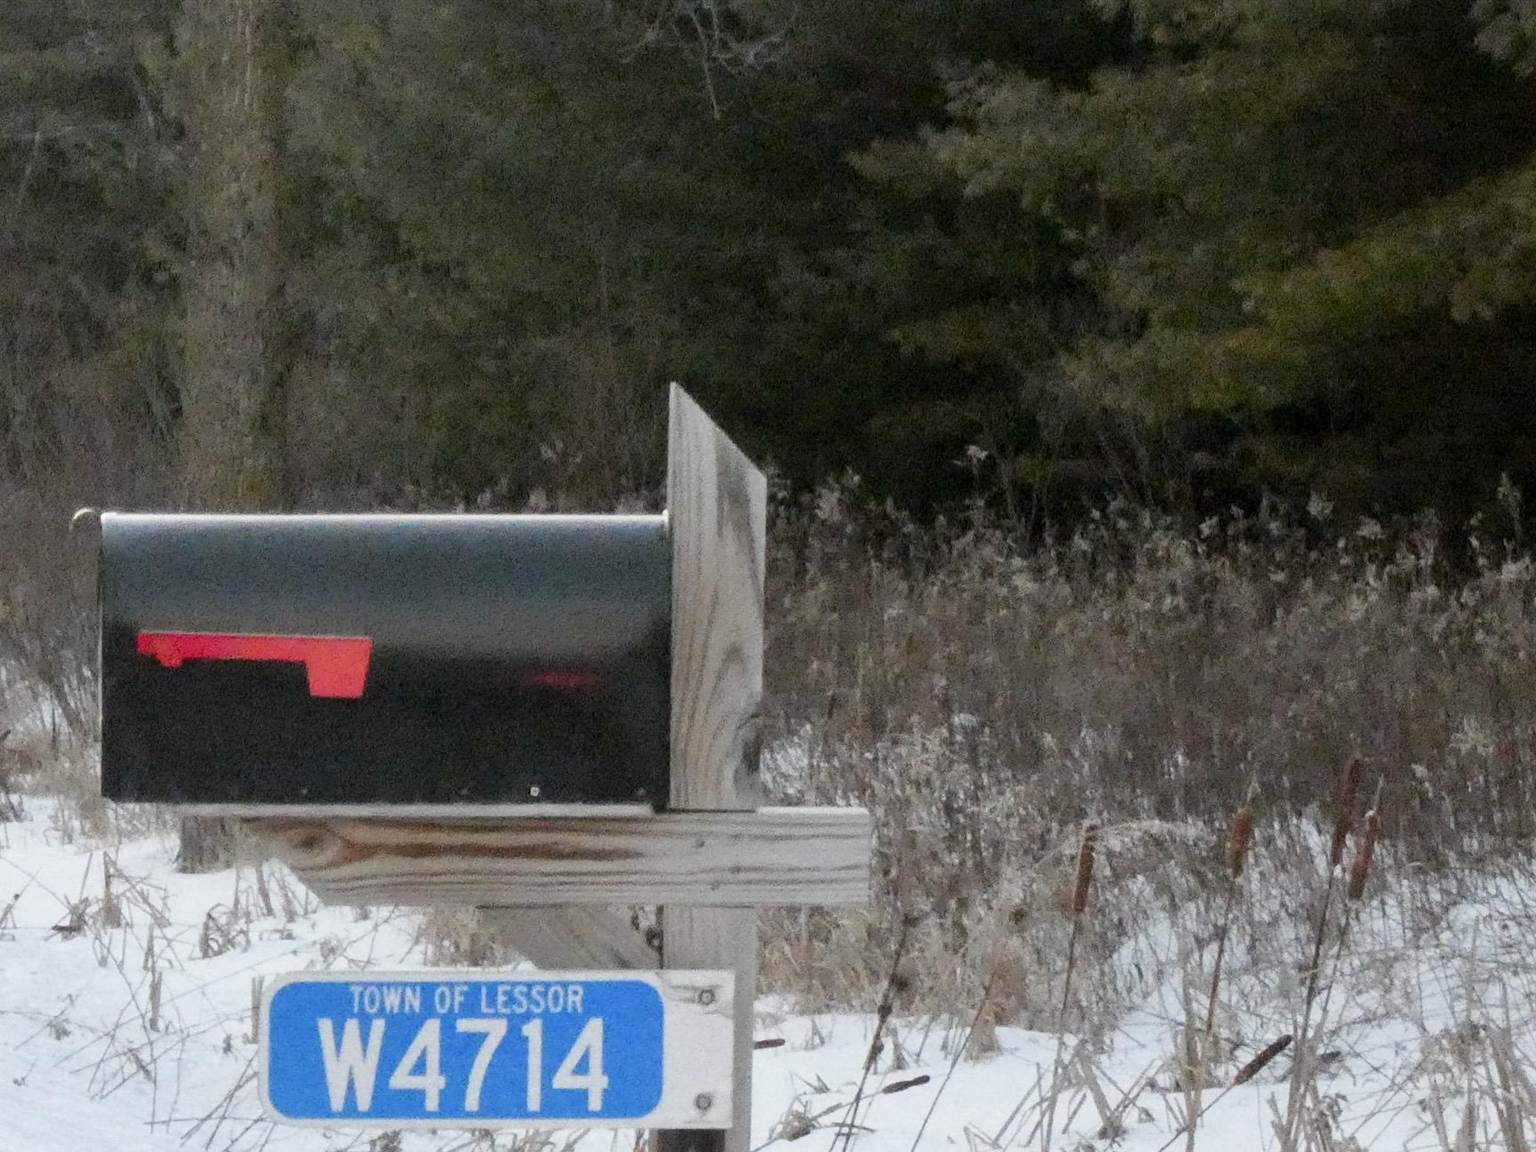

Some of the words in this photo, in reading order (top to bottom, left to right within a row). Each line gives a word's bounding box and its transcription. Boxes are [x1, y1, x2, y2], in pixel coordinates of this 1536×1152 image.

[349, 986, 423, 1014] TOWN
[435, 986, 468, 1014] OF
[480, 986, 584, 1014] LESSOR
[318, 1018, 609, 1112] W4714
